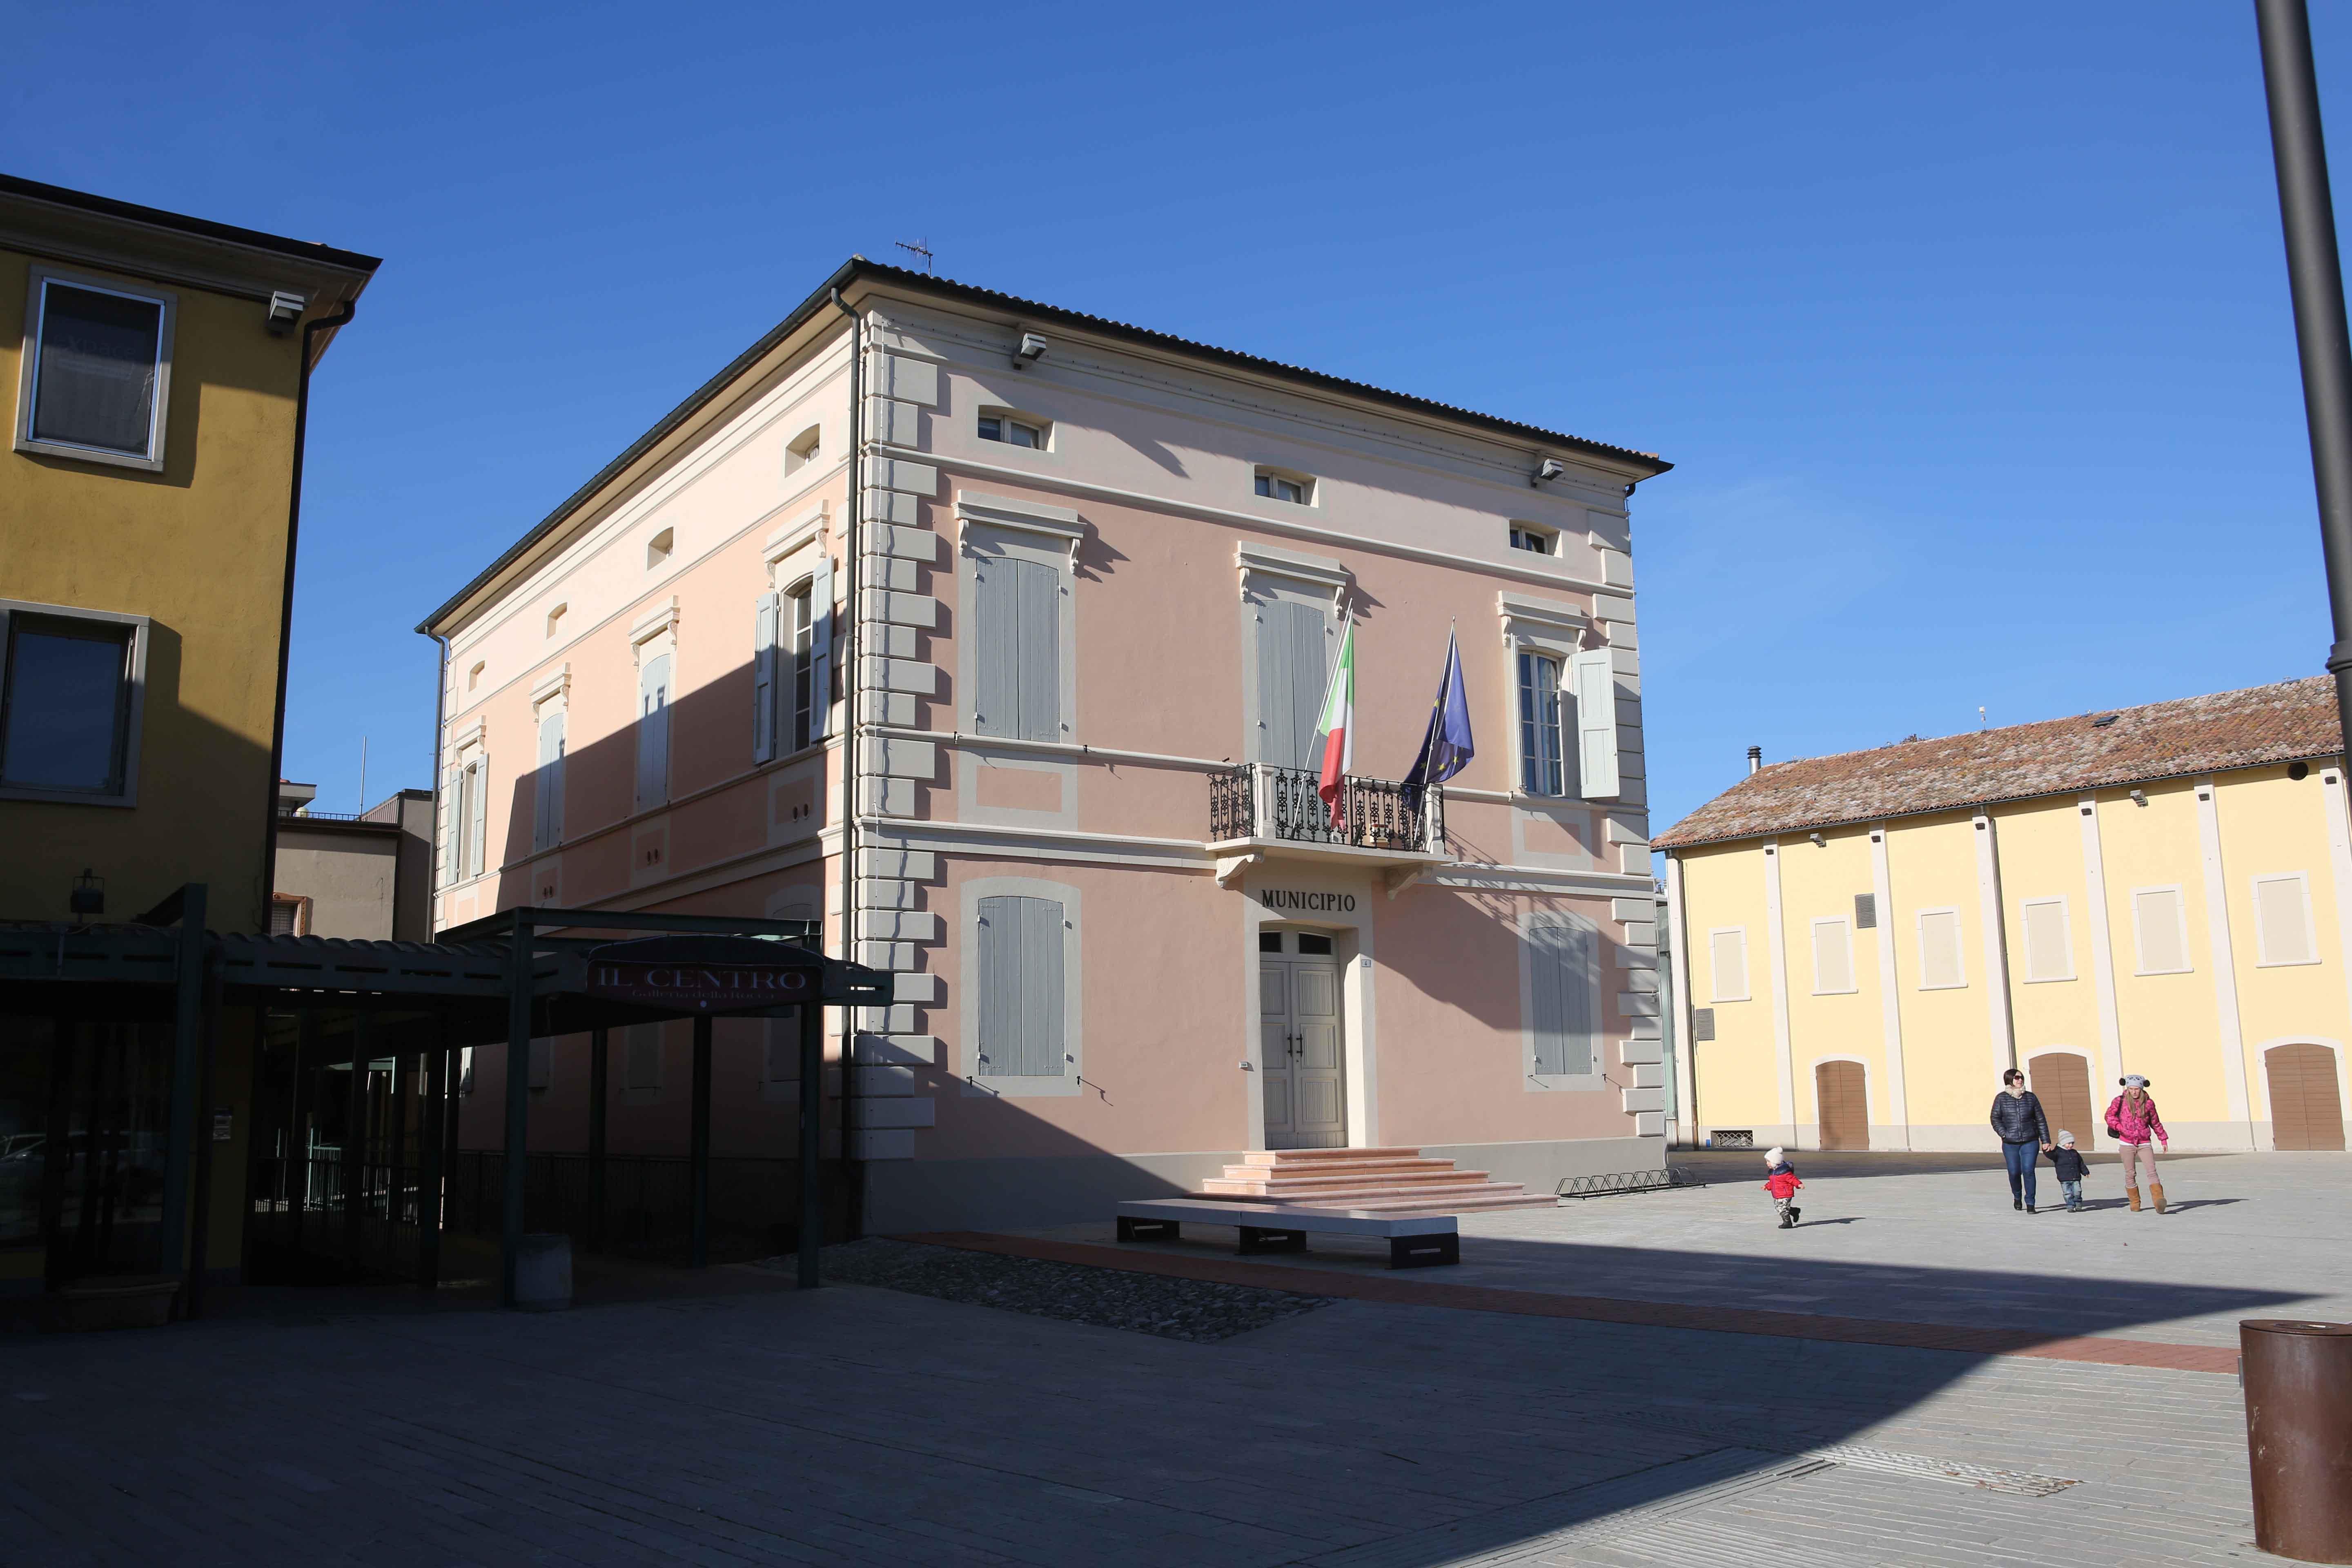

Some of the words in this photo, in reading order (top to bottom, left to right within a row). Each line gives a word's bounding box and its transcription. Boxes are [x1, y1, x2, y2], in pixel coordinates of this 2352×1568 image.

[1262, 889, 1355, 911] MUNICIPIO
[596, 967, 633, 987] IL
[644, 969, 806, 989] CENTRO
